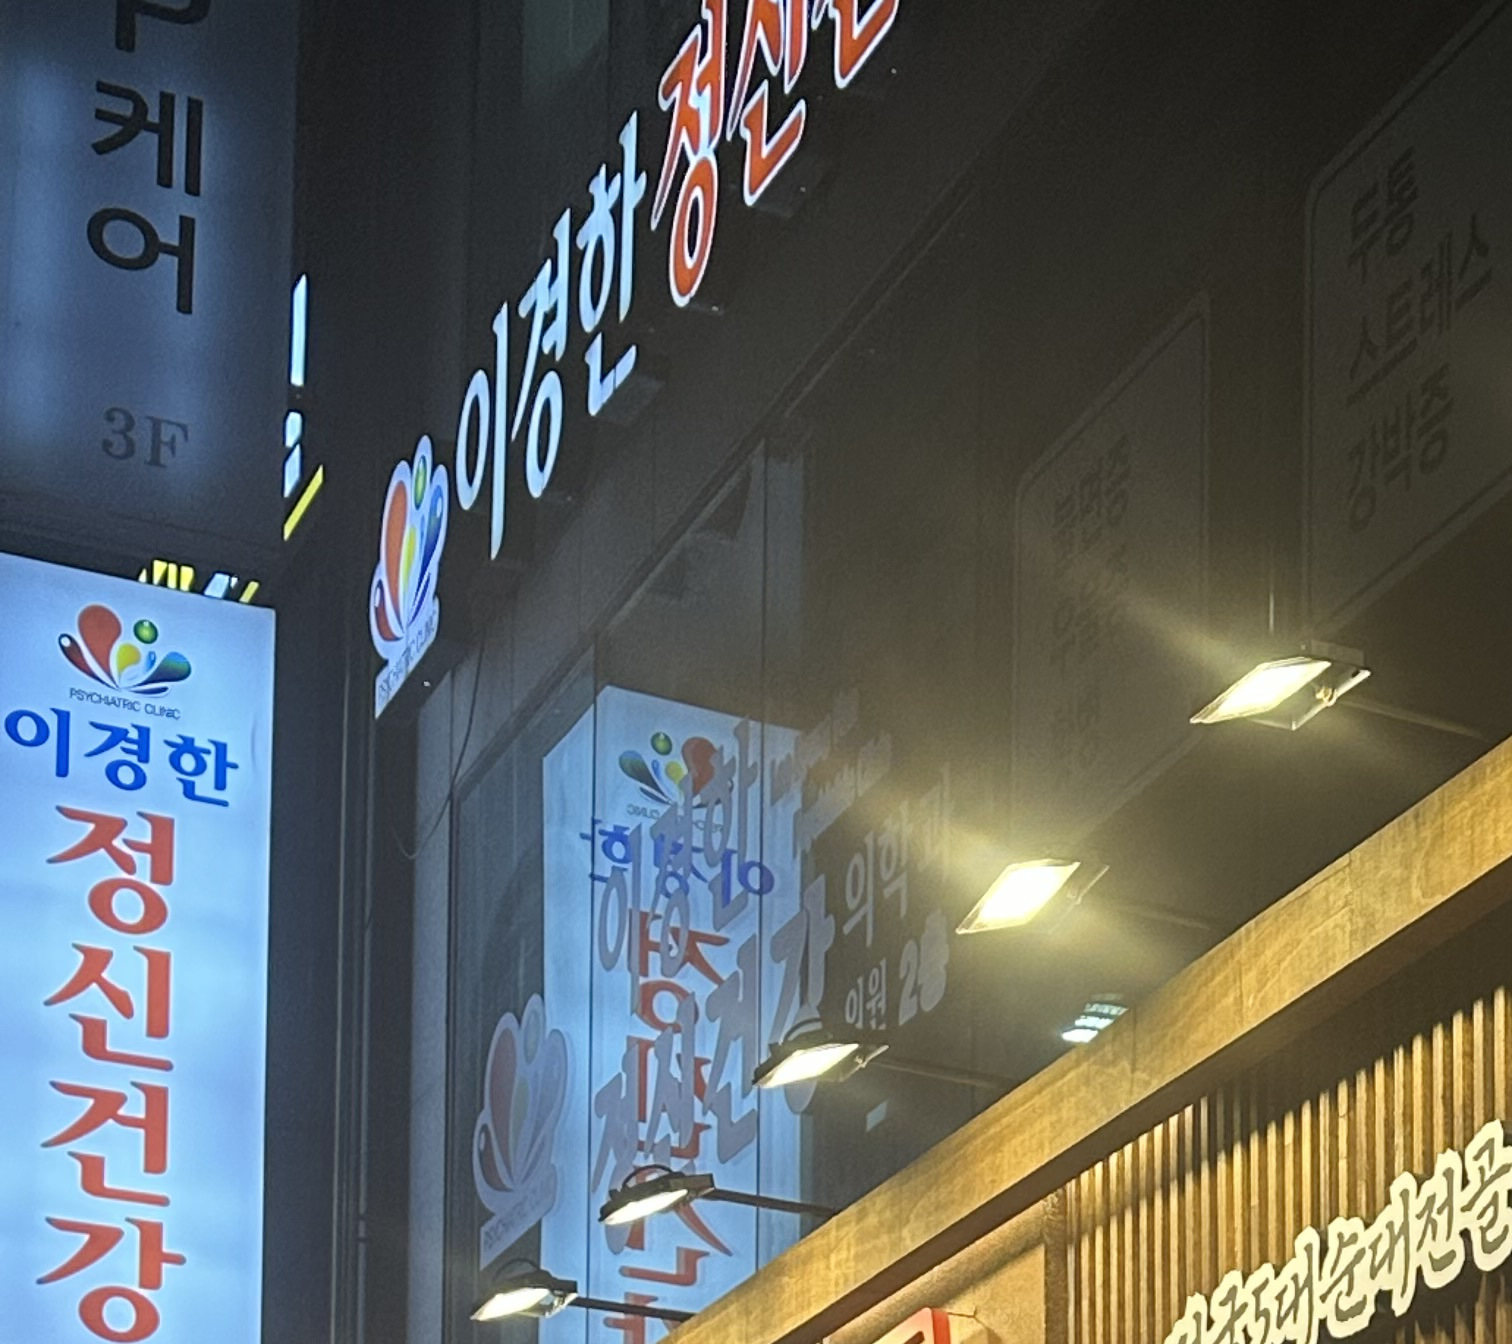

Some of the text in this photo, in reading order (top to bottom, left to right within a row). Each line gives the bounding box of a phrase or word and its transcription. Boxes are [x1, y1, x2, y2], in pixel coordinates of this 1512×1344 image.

[455, 0, 902, 560] 이경한 정신
[1346, 210, 1494, 408] 스트레스
[101, 406, 190, 470] 3F
[4, 707, 239, 808] 이경한
[36, 804, 187, 1344] 정신건강
